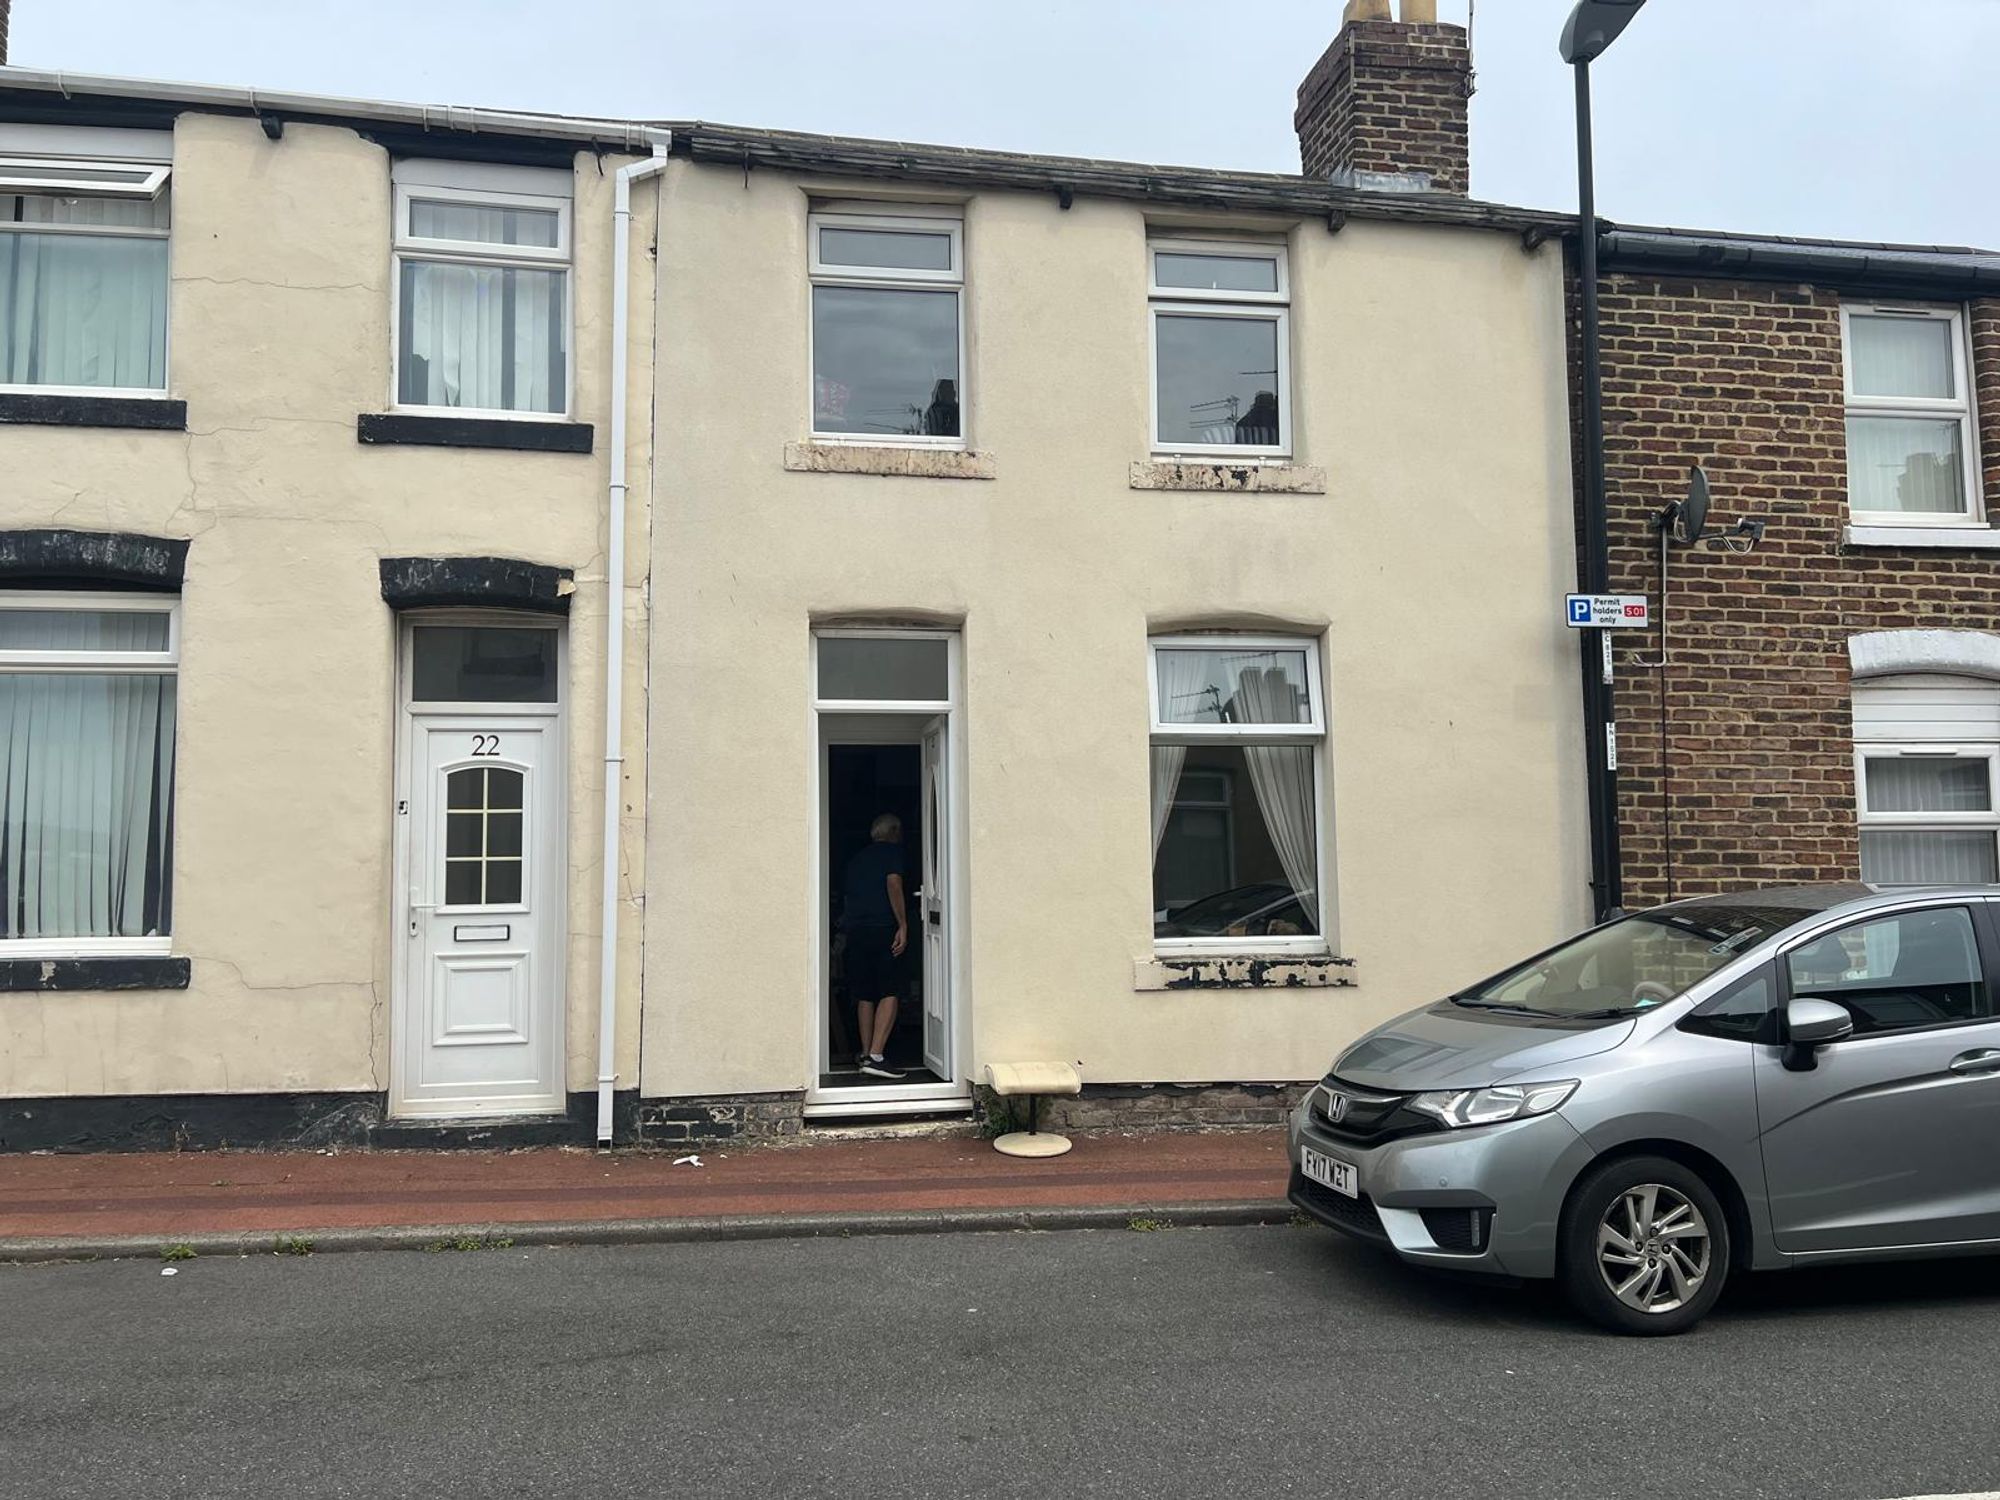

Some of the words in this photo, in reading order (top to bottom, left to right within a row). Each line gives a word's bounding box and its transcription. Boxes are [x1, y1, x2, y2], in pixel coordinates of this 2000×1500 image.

[1574, 601, 1588, 620] P
[1593, 607, 1622, 615] holders
[1600, 616, 1616, 624] only
[471, 735, 500, 756] 22
